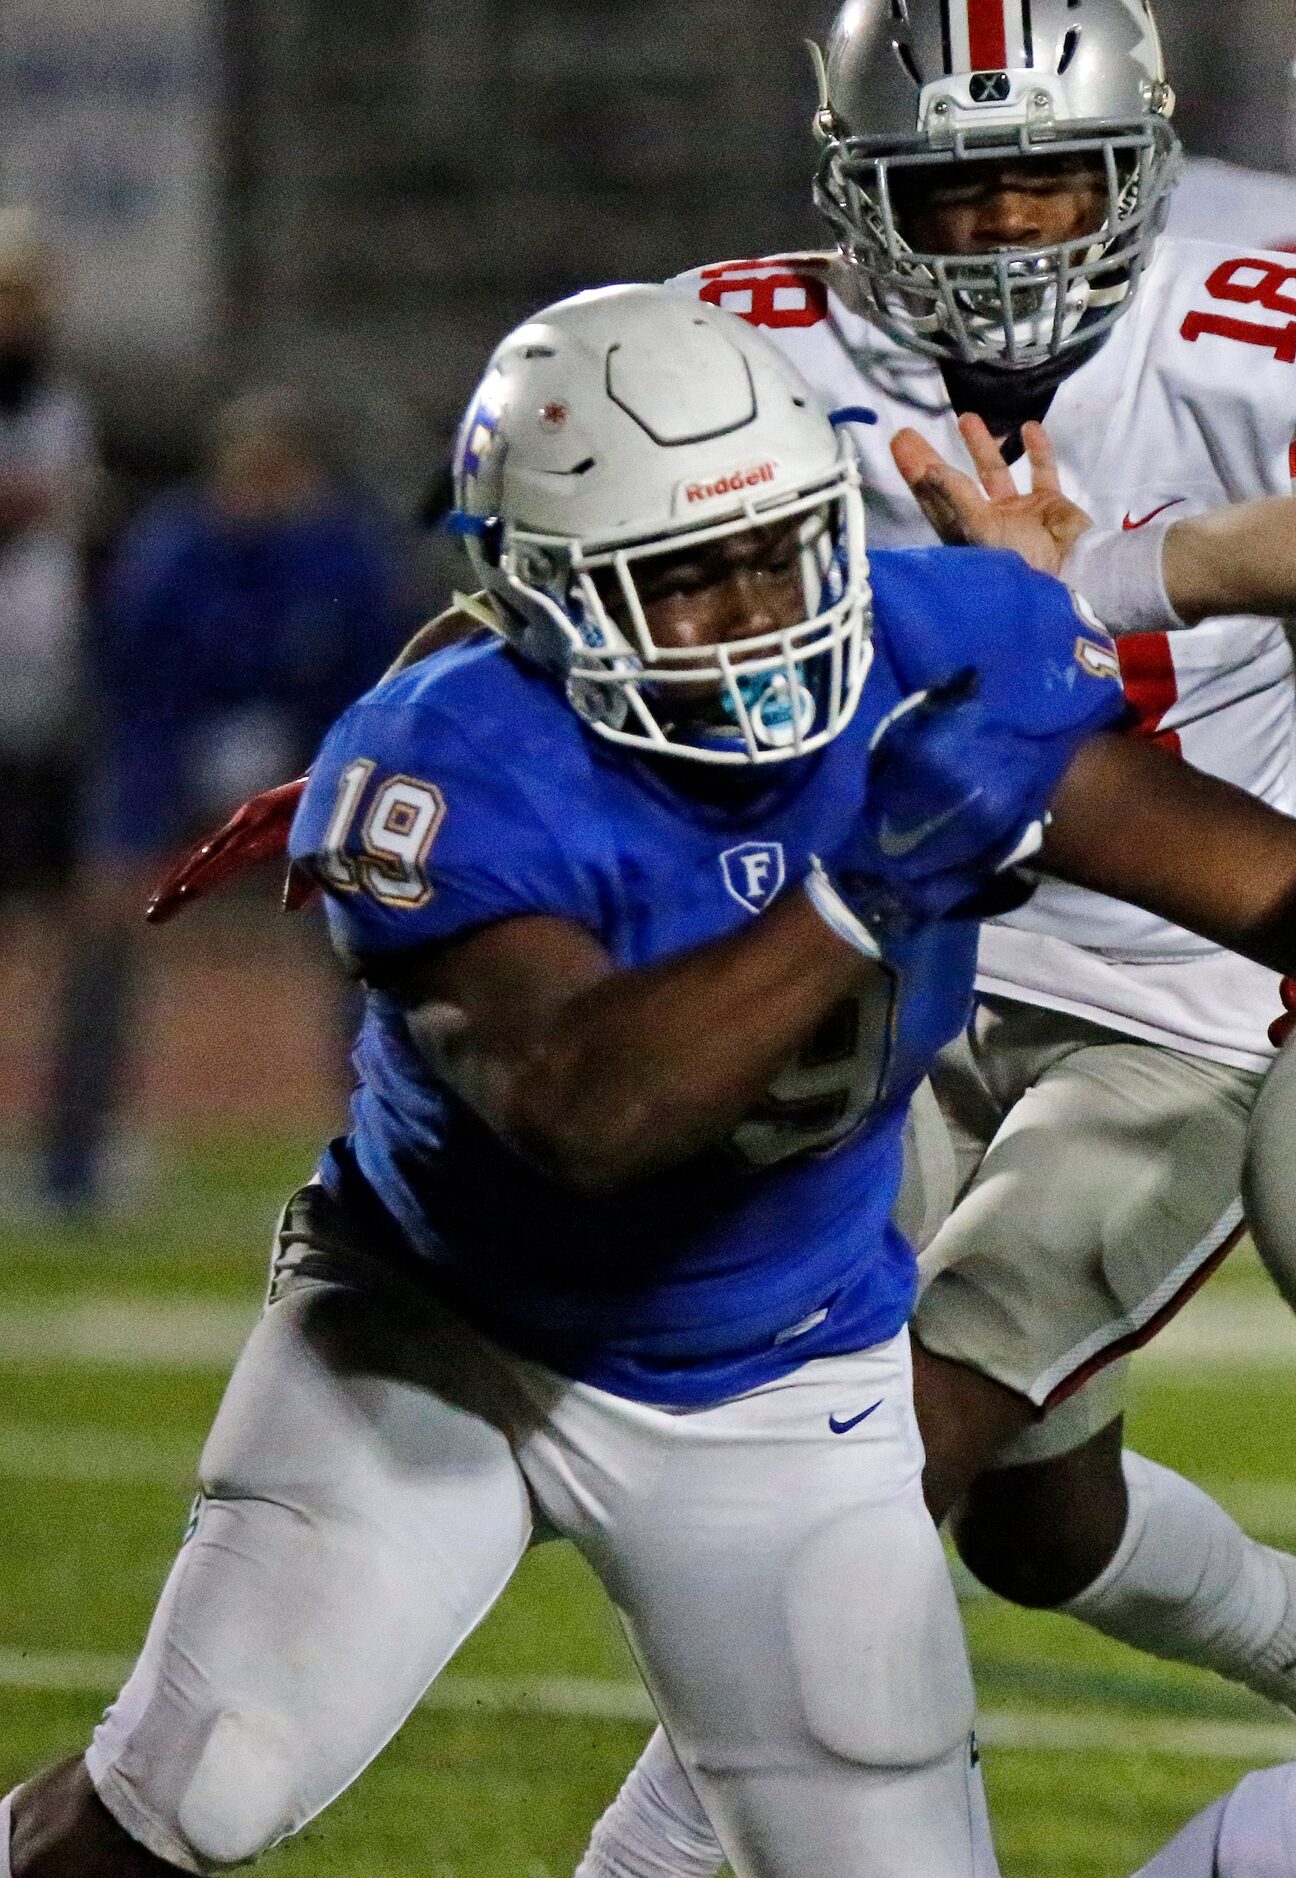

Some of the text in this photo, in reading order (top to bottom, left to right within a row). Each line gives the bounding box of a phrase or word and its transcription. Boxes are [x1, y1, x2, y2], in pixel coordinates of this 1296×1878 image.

[686, 462, 778, 503] Riddell
[322, 757, 448, 910] 19
[741, 851, 771, 897] F
